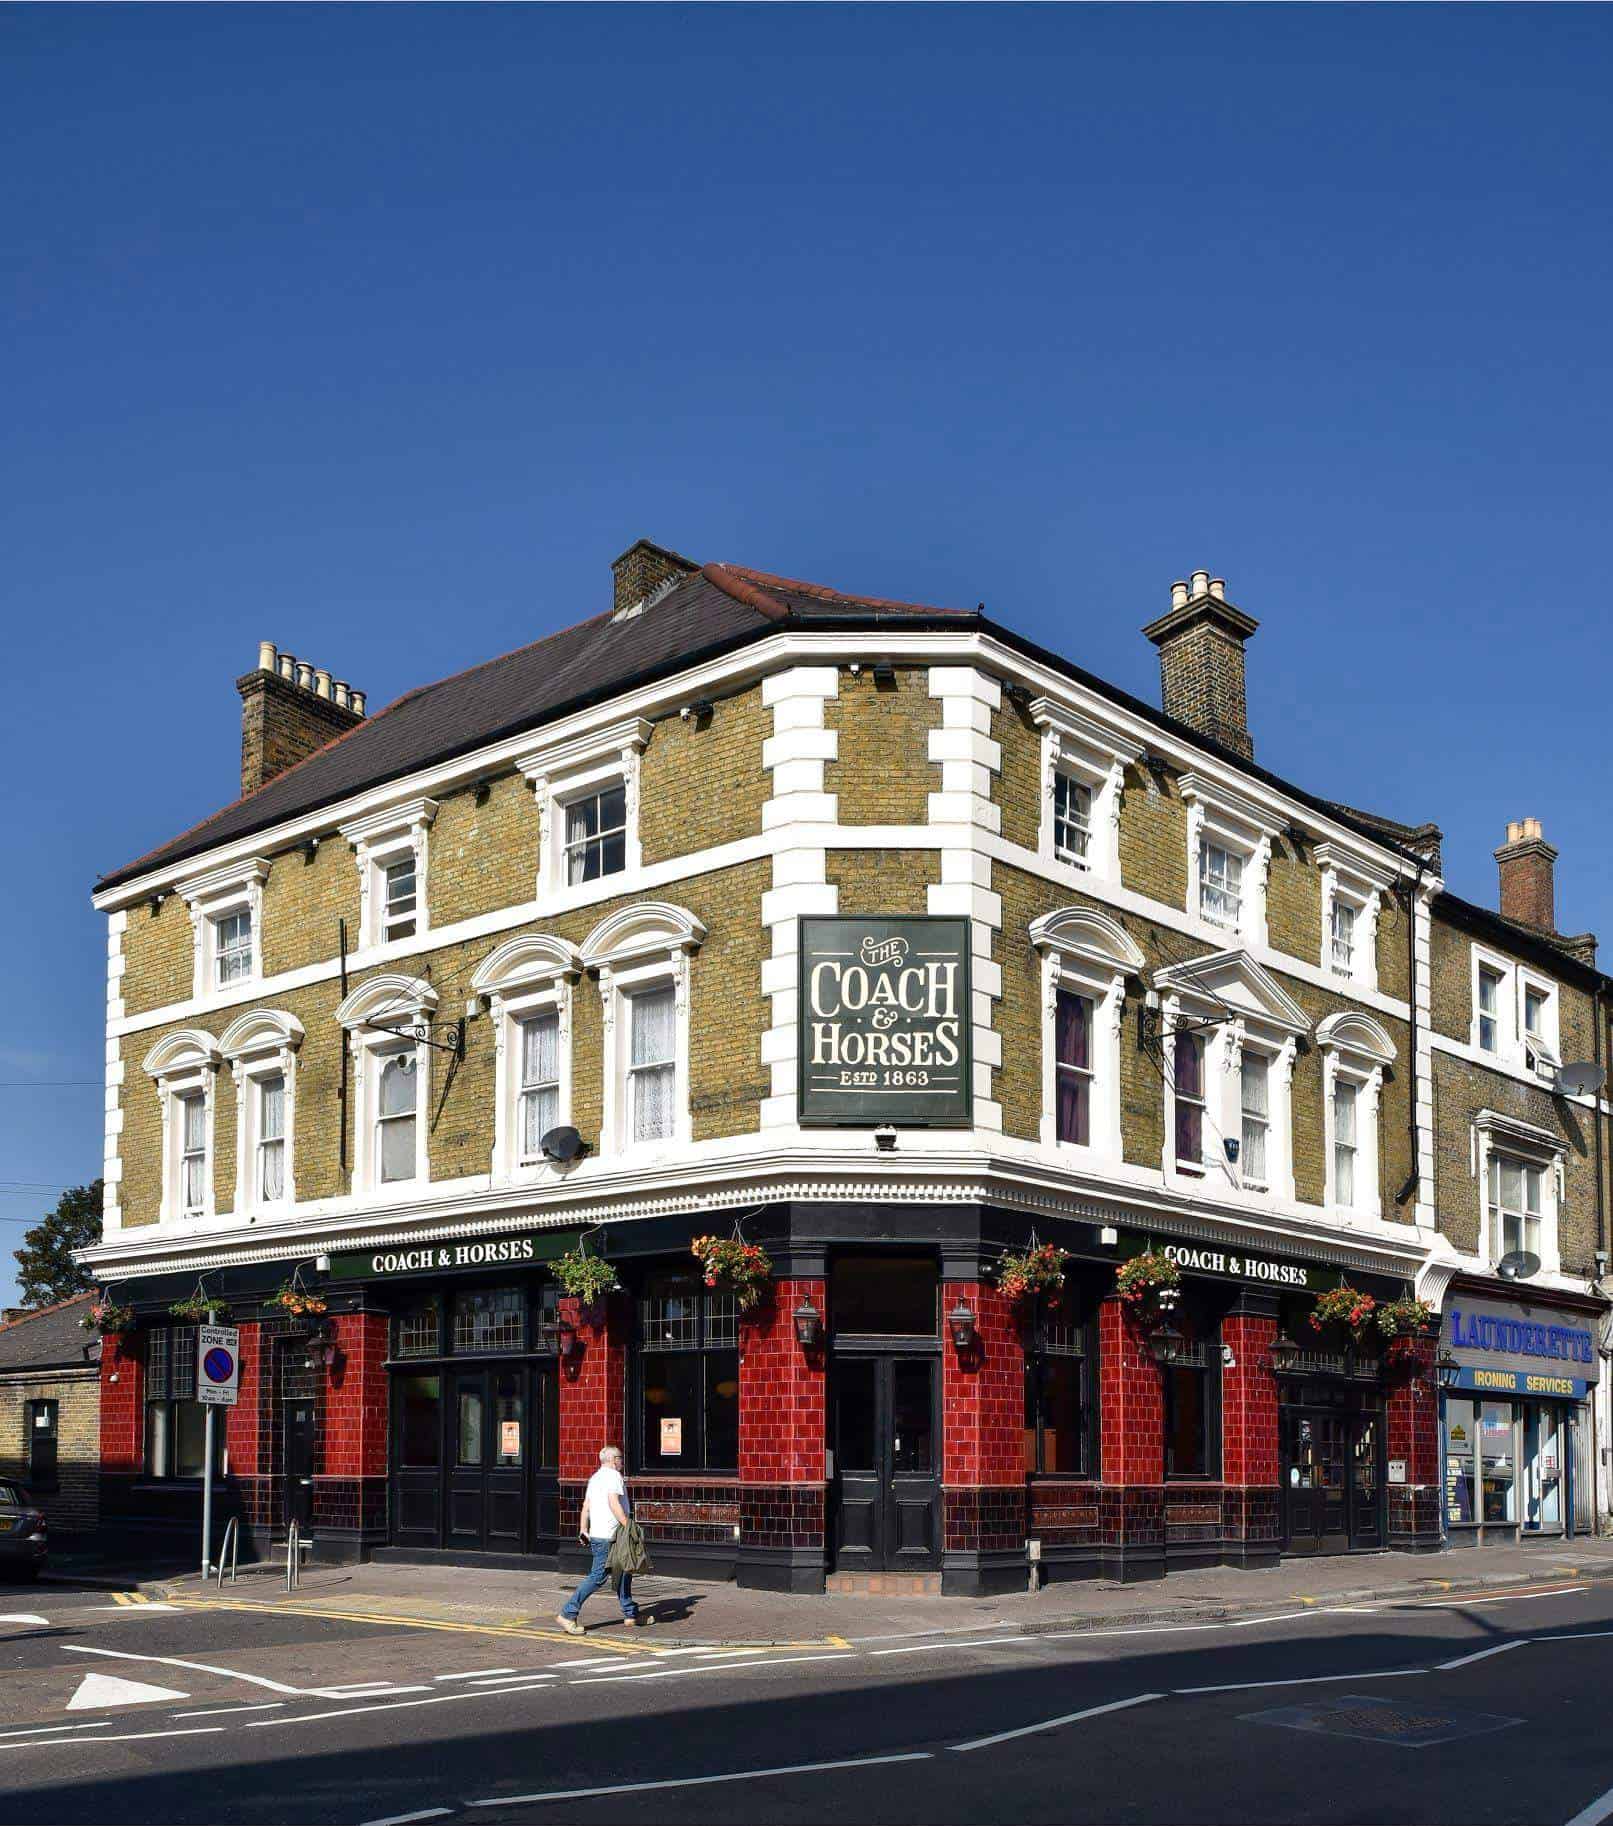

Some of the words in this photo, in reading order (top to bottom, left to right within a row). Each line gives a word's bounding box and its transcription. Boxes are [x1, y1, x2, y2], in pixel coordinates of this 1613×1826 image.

[868, 941, 900, 964] THE
[811, 961, 958, 1018] COACH
[872, 1007, 898, 1029] &
[811, 1021, 958, 1066] HORSES
[839, 1071, 878, 1085] ESTD
[883, 1071, 929, 1085] 1863
[372, 1250, 434, 1273] COACH
[438, 1249, 451, 1266] &
[455, 1239, 534, 1265] HORSES
[1164, 1245, 1225, 1272] COACH
[1229, 1256, 1241, 1274] &
[1244, 1258, 1308, 1286] HORSES
[201, 1326, 238, 1337] Controlled
[201, 1335, 224, 1345] ZONE
[1451, 1310, 1593, 1363] LAUNDERETTE
[1474, 1370, 1516, 1390] IRONING
[1526, 1376, 1573, 1394] SERVICES
